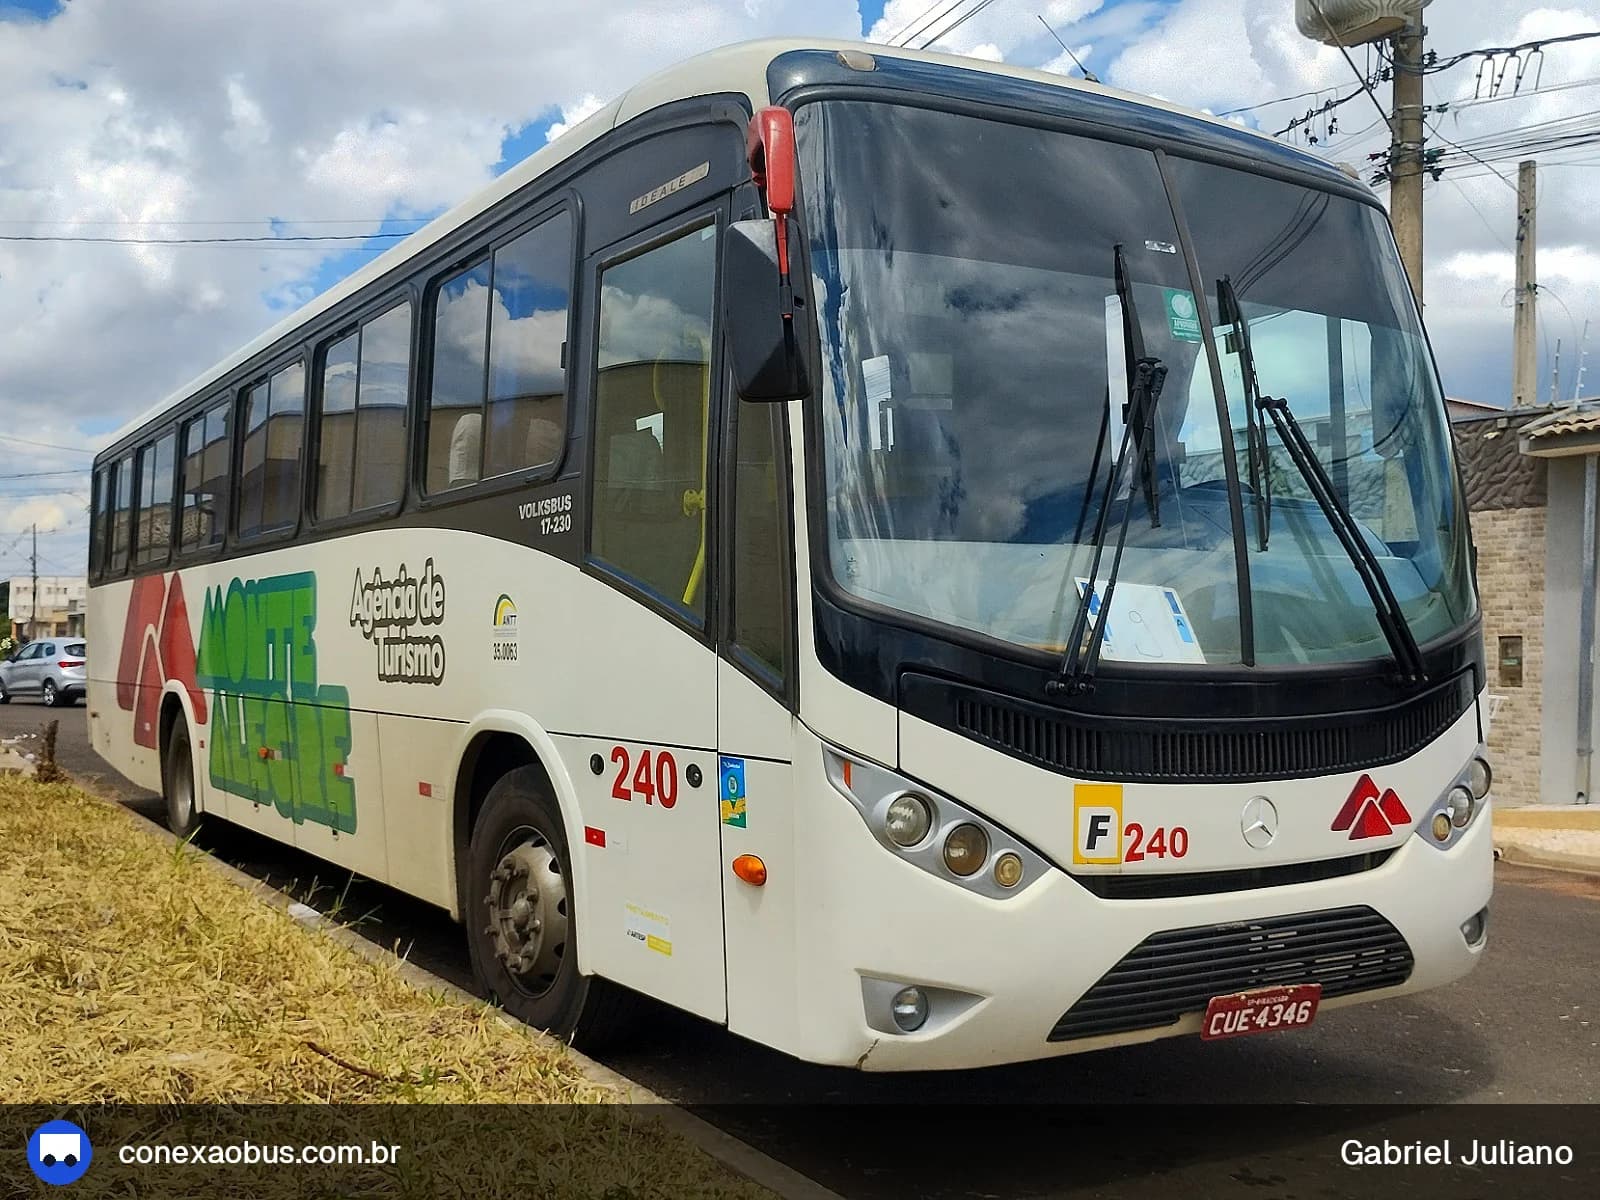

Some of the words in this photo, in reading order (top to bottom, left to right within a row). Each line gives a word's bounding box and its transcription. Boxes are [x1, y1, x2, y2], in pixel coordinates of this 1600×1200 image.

[634, 175, 687, 211] IDEALE
[518, 494, 572, 520] VOLKSBUS
[540, 514, 571, 535] 17-230
[350, 563, 418, 640] Agência
[419, 557, 445, 626] de
[196, 570, 317, 692] MONTE
[502, 614, 518, 626] ANTT
[373, 625, 446, 687] Turismo
[209, 684, 358, 835] ALEGRE
[610, 745, 678, 809] 240
[1085, 815, 1111, 850] F
[1123, 822, 1189, 863] 240
